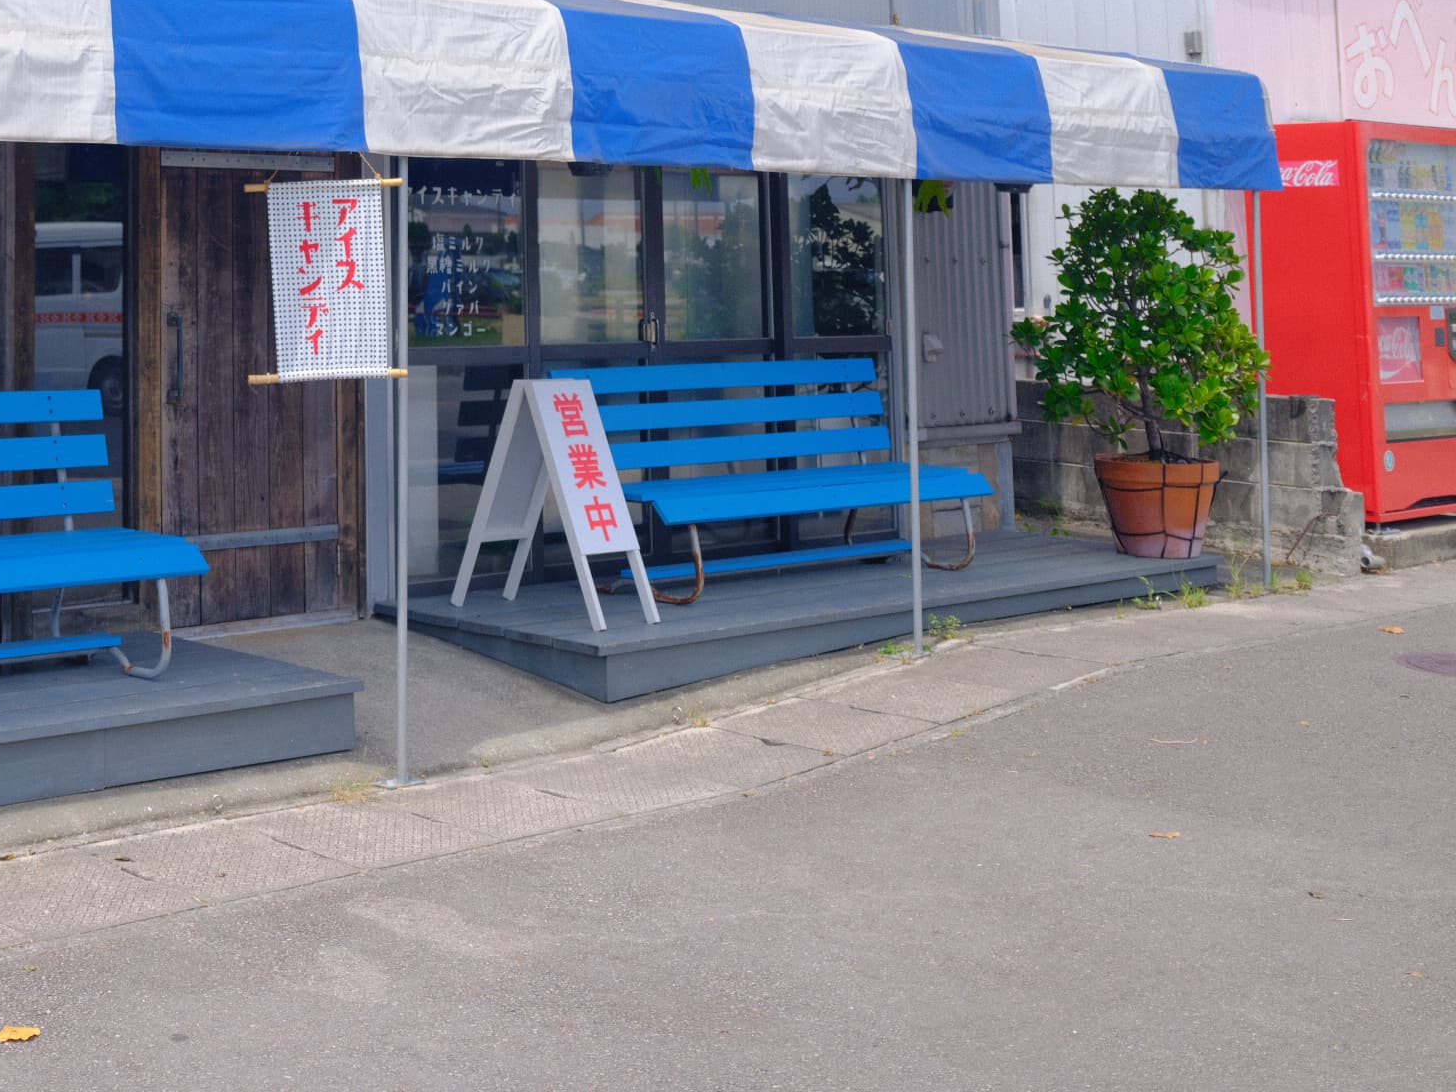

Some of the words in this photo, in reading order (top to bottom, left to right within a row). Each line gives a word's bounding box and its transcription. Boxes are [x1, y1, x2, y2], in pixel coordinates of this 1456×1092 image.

[296, 200, 330, 355] キャンディ
[331, 198, 365, 292] アイス
[552, 392, 619, 543] 営業中
